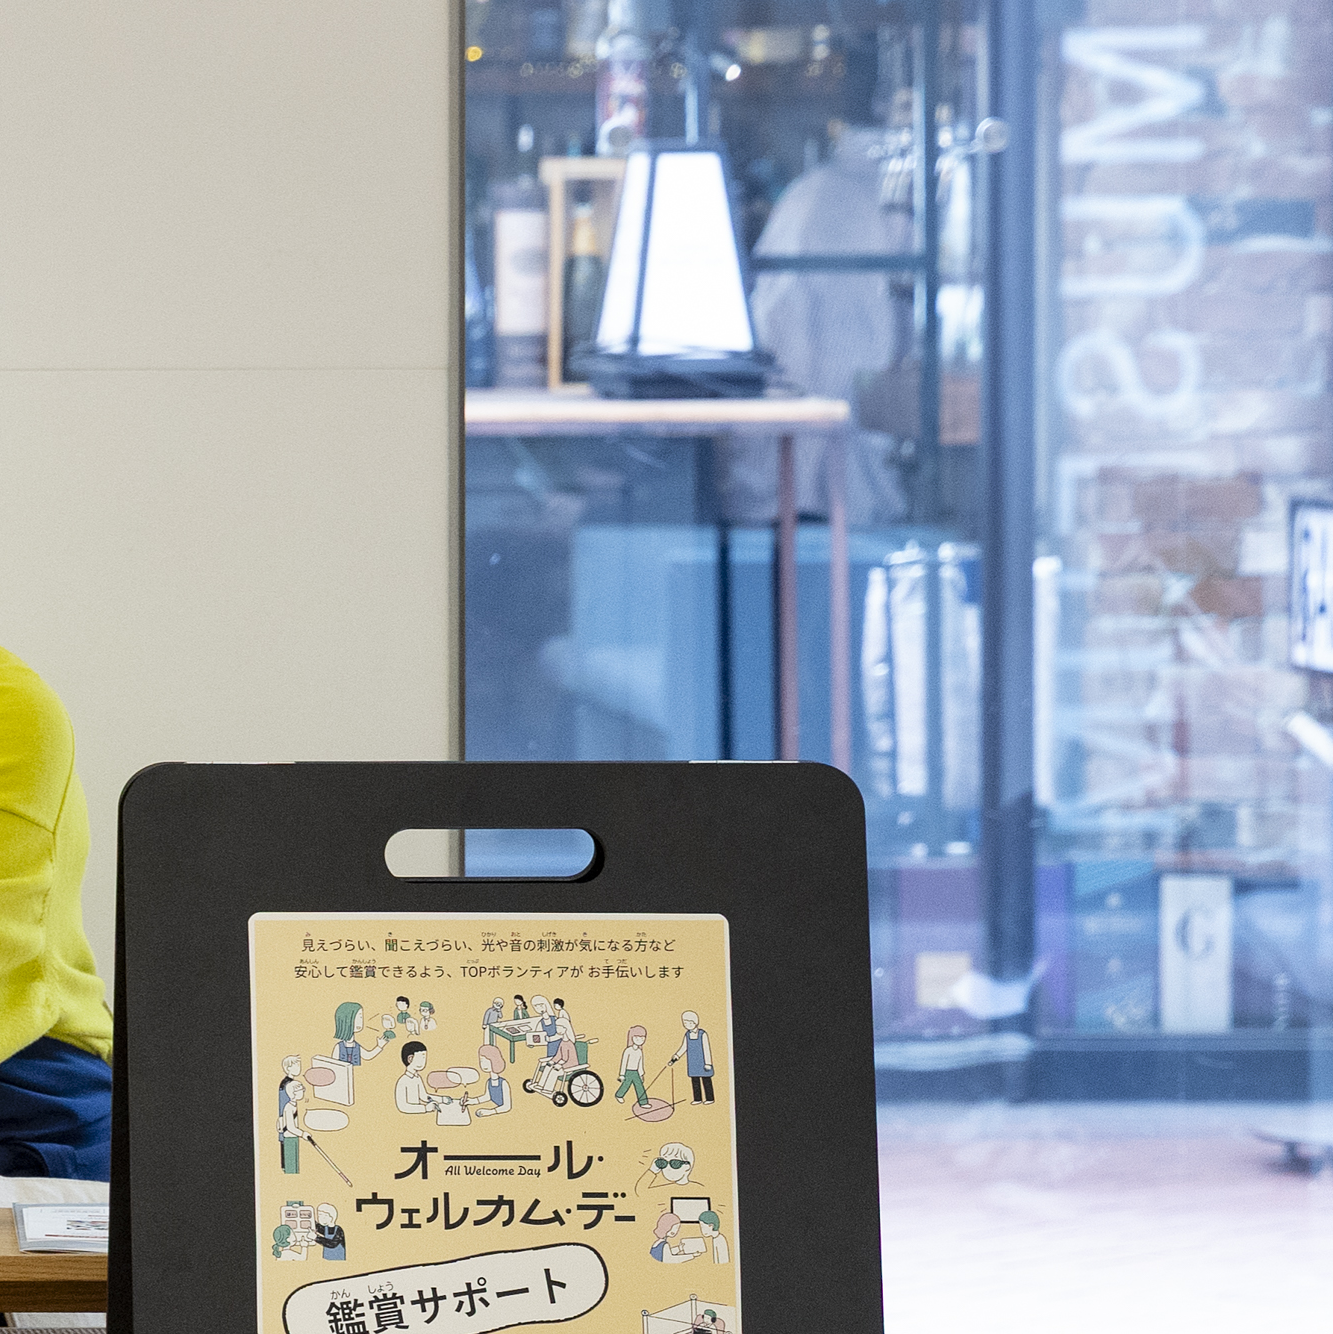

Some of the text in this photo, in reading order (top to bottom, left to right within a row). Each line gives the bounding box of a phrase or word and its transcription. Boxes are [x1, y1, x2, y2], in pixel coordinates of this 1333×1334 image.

[444, 1165, 541, 1178] All Welcome Day
[356, 1192, 635, 1230] ウェルカム・デー
[330, 1281, 394, 1300] かん しょう
